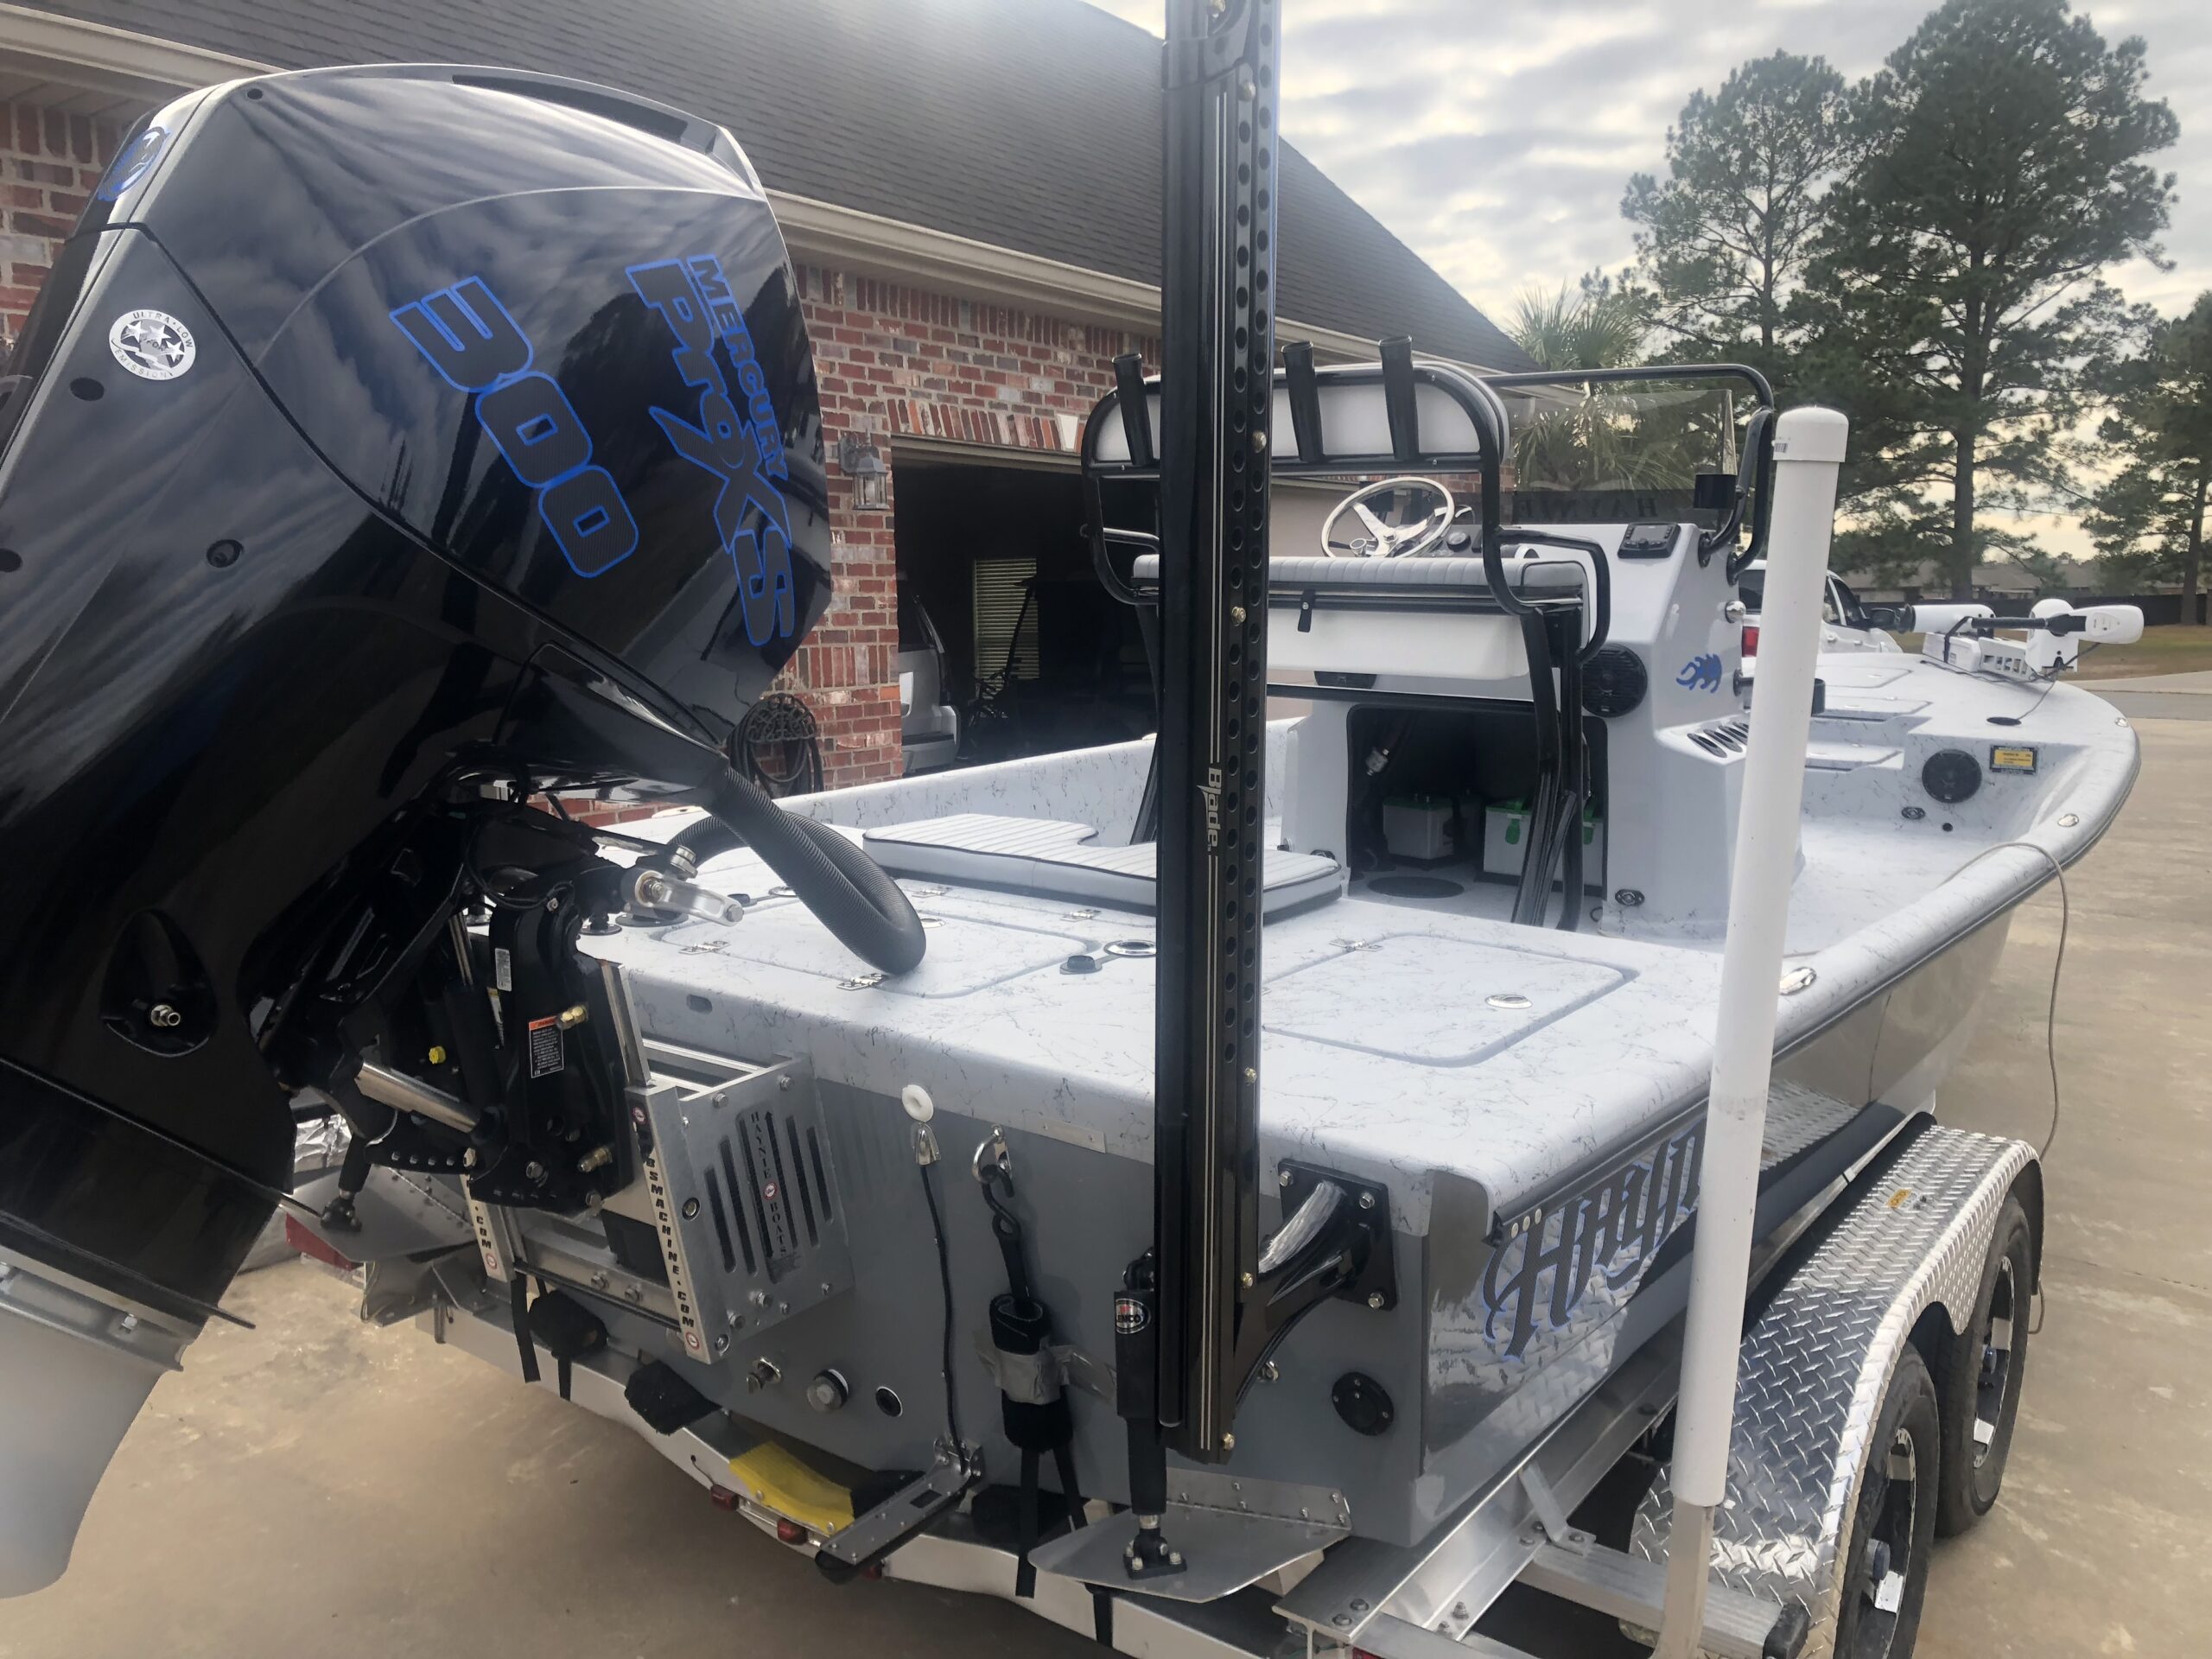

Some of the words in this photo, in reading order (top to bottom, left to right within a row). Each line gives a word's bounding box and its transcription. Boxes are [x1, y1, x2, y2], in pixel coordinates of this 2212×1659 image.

[132, 311, 171, 324] ULTRA
[176, 326, 194, 348] LOW
[687, 254, 788, 480] MERCURY
[389, 276, 639, 578] 300
[1196, 766, 1222, 848] Blade
[474, 1205, 492, 1249] .COM
[645, 1156, 695, 1329] BSMACHINE.COM
